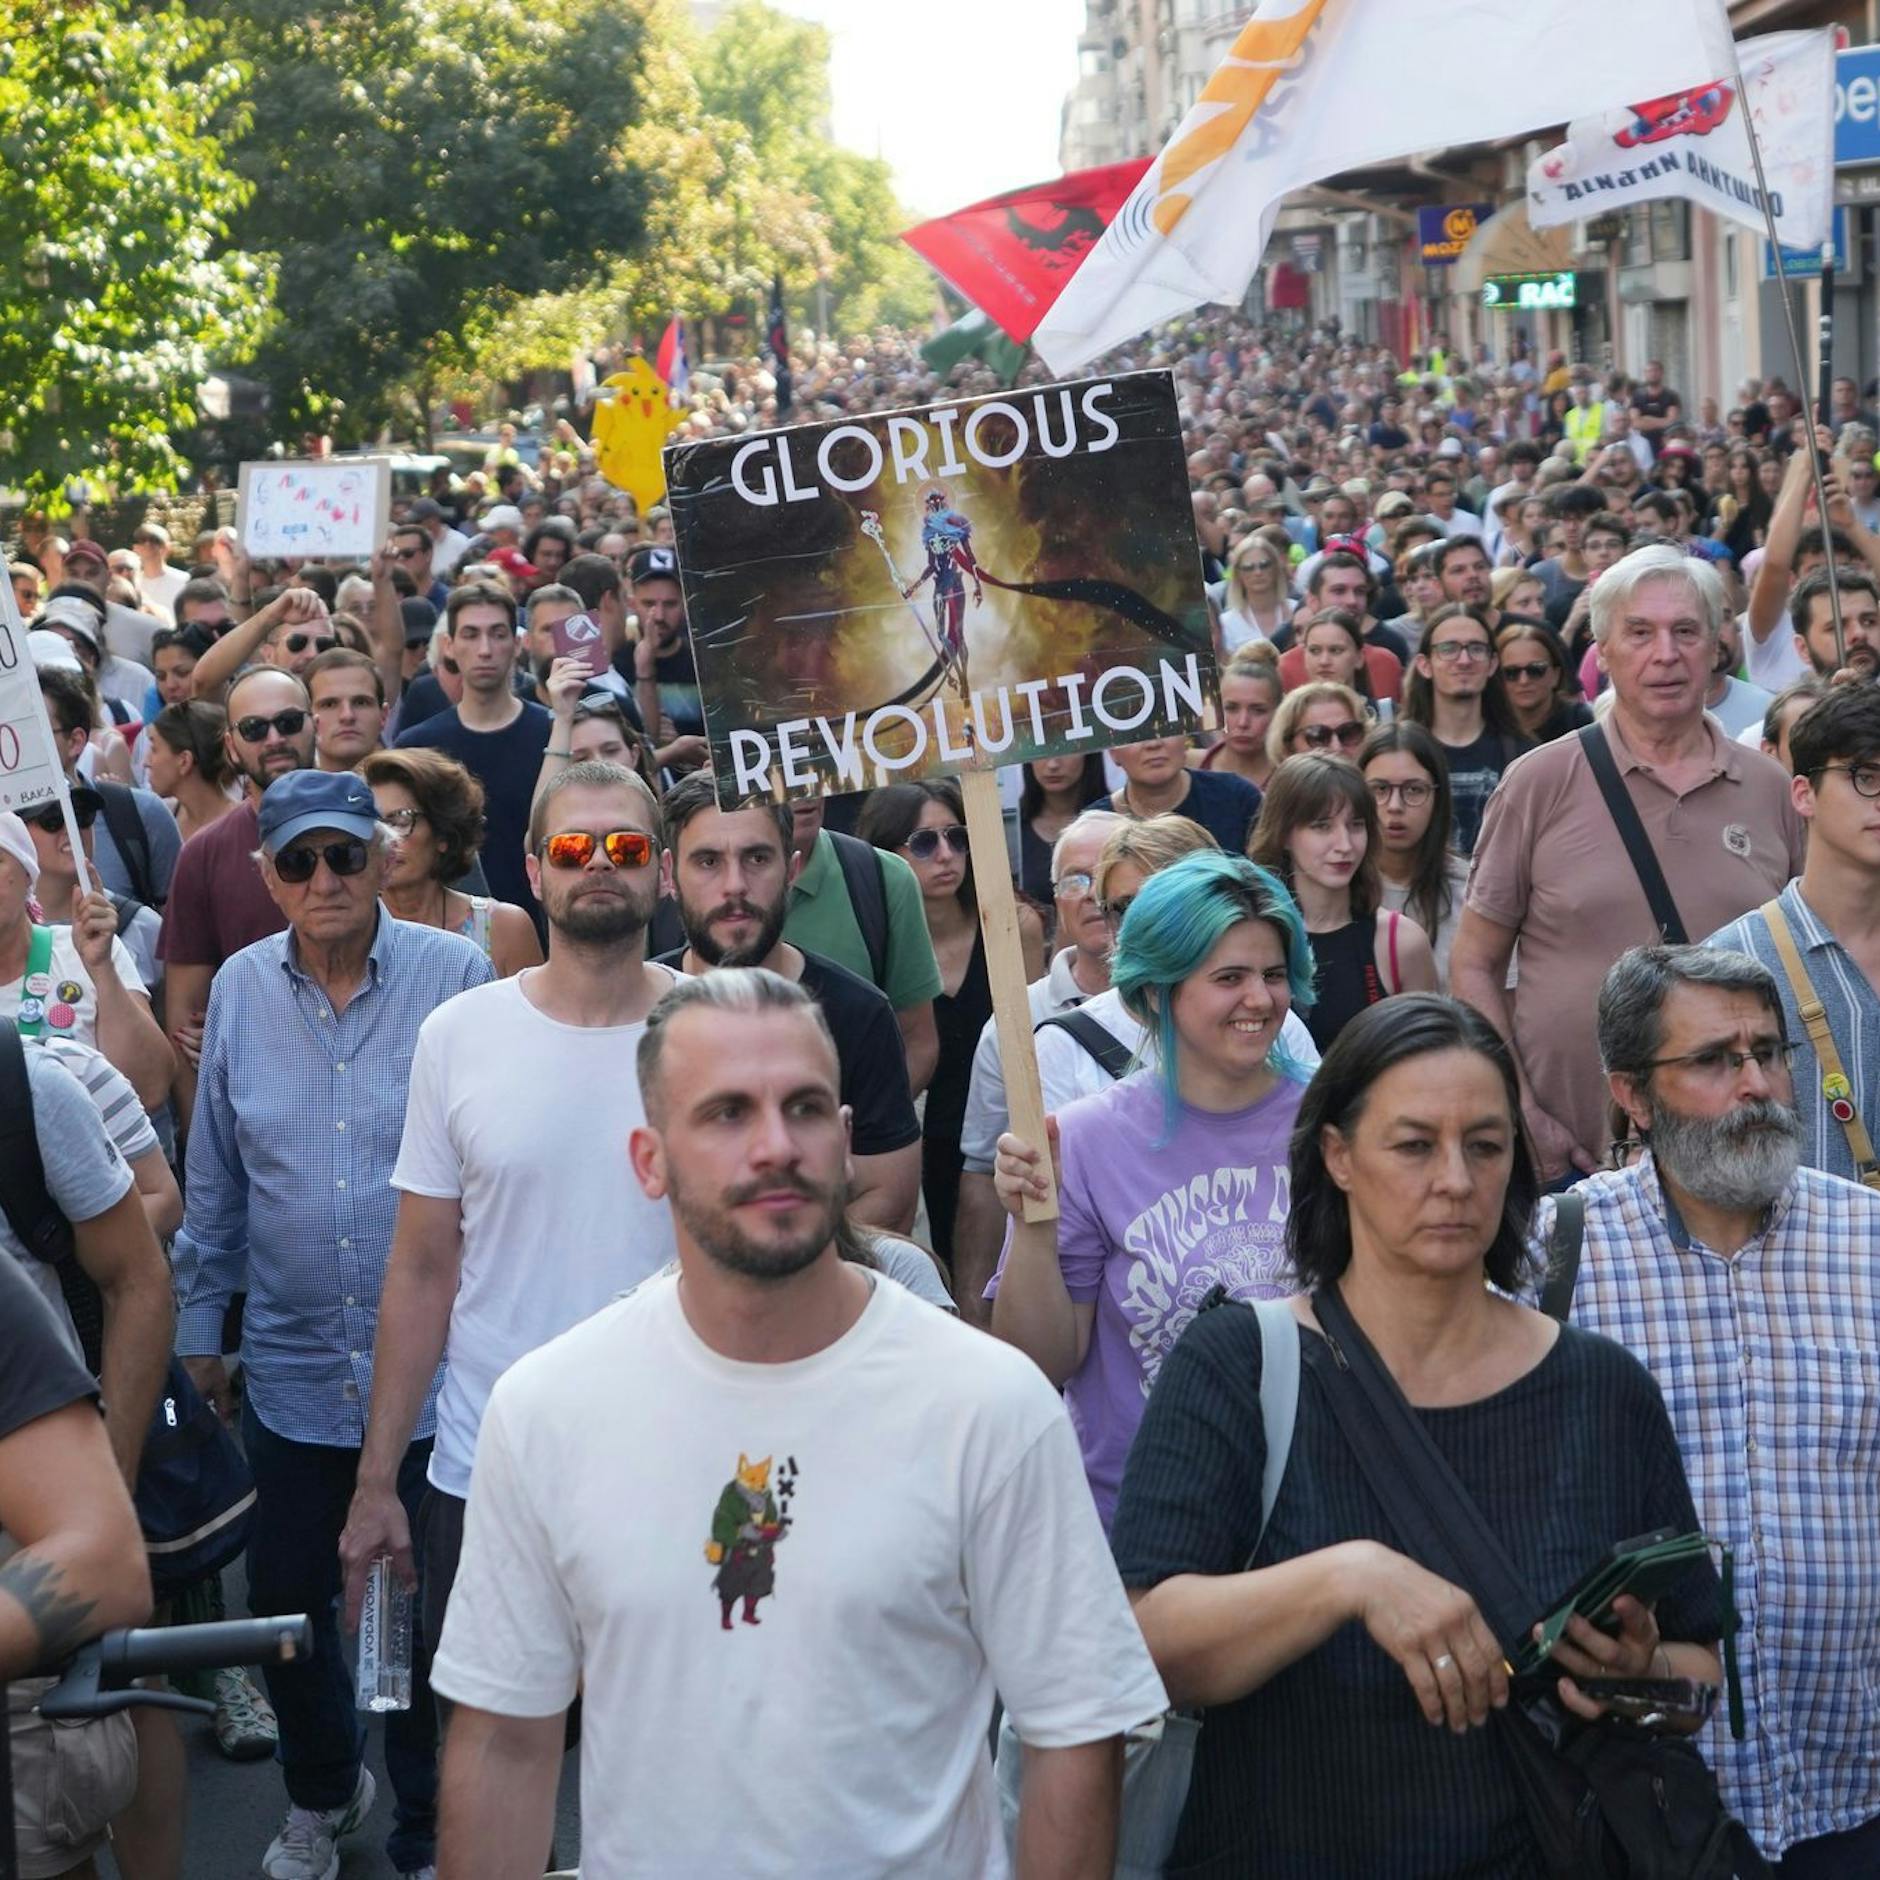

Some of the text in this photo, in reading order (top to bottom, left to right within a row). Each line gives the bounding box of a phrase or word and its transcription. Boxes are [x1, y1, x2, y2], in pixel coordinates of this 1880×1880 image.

[731, 384, 1119, 506] GLORIOUS
[729, 652, 1204, 795] REVOLUTION
[1124, 1167, 1258, 1288] SUNSET
